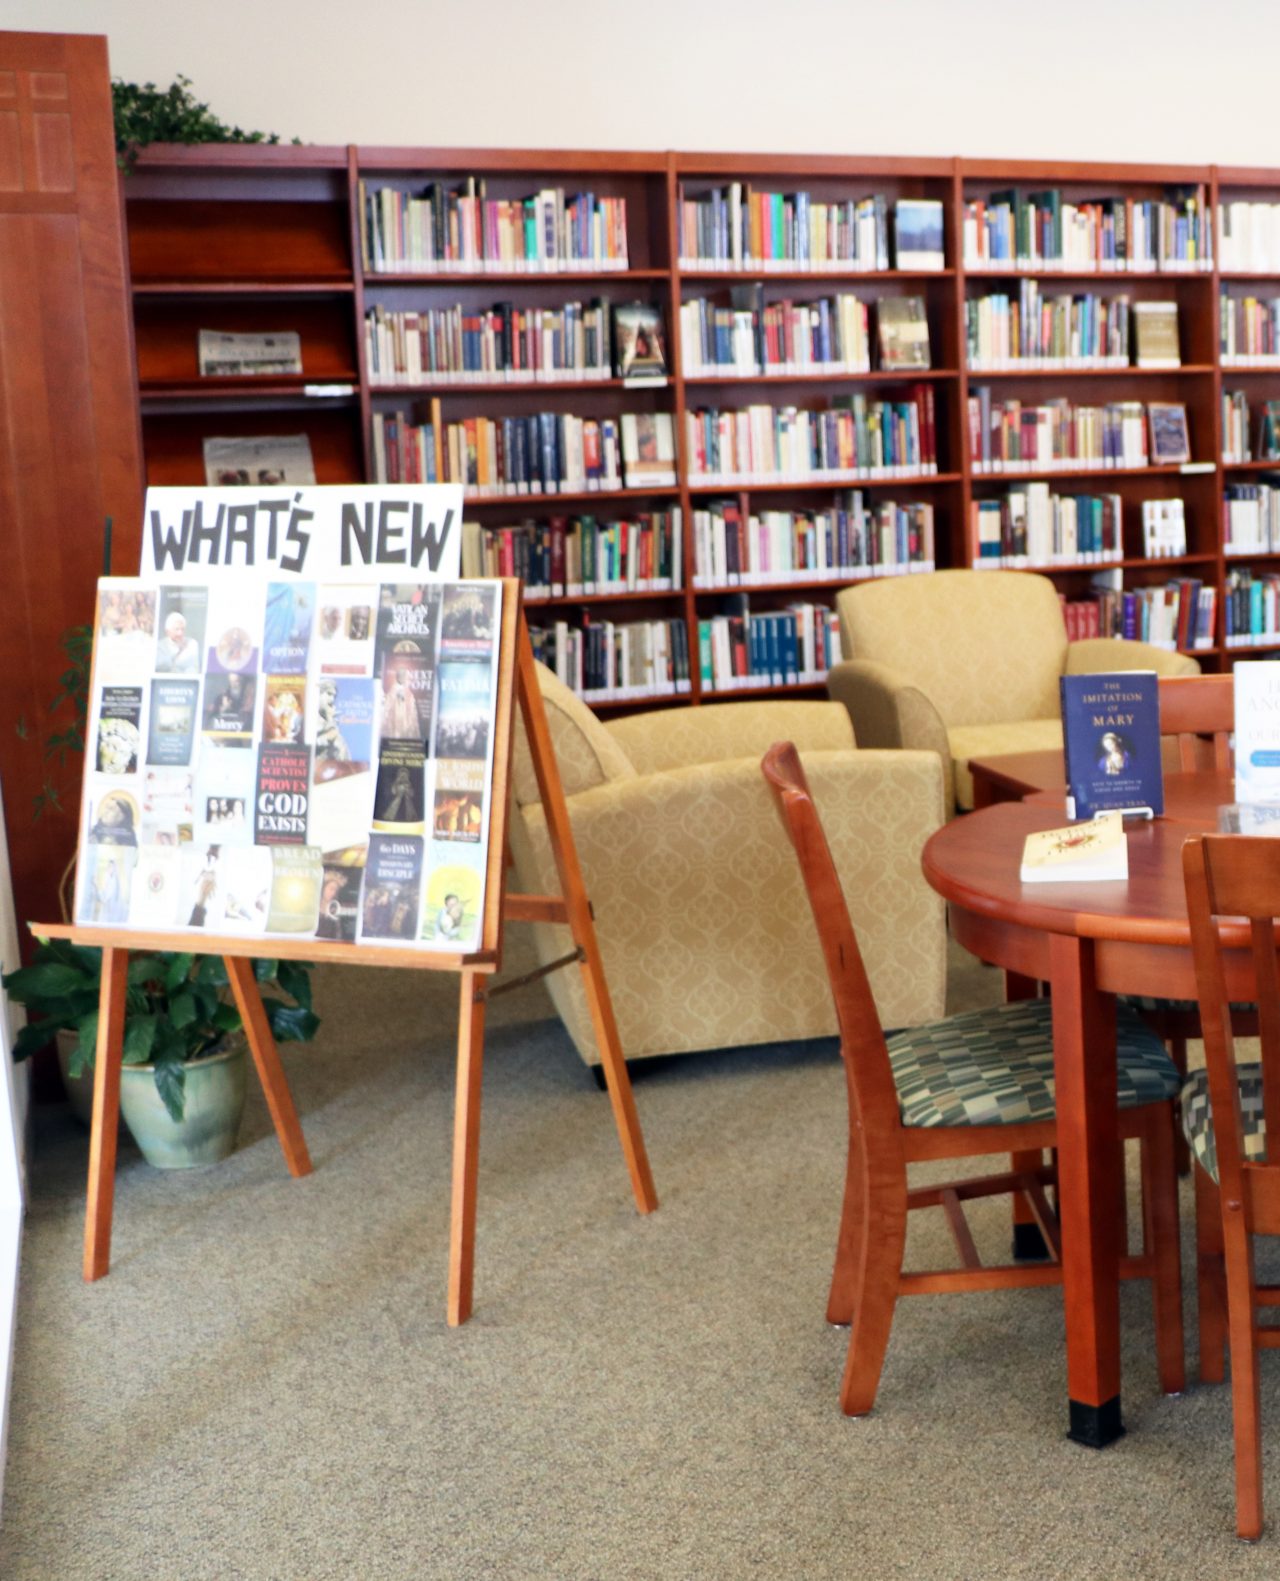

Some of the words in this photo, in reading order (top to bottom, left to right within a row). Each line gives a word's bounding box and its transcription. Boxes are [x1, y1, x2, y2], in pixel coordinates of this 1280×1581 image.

[150, 491, 315, 573] WHAT'S
[341, 500, 455, 572] NEW
[387, 623, 430, 635] ARCHIVES
[270, 647, 305, 658] OPTION
[1104, 682, 1121, 690] THE
[1082, 693, 1143, 704] IMITATION
[212, 718, 243, 732] Mercy
[1092, 714, 1135, 727] MARY
[262, 757, 307, 767] CATHOLIC
[405, 759, 425, 768] MERC
[261, 767, 307, 777] SCIENTIST
[260, 778, 306, 791] PROVES
[258, 793, 307, 815] GOD
[258, 816, 306, 832] EXISTS
[392, 843, 416, 855] DAYS
